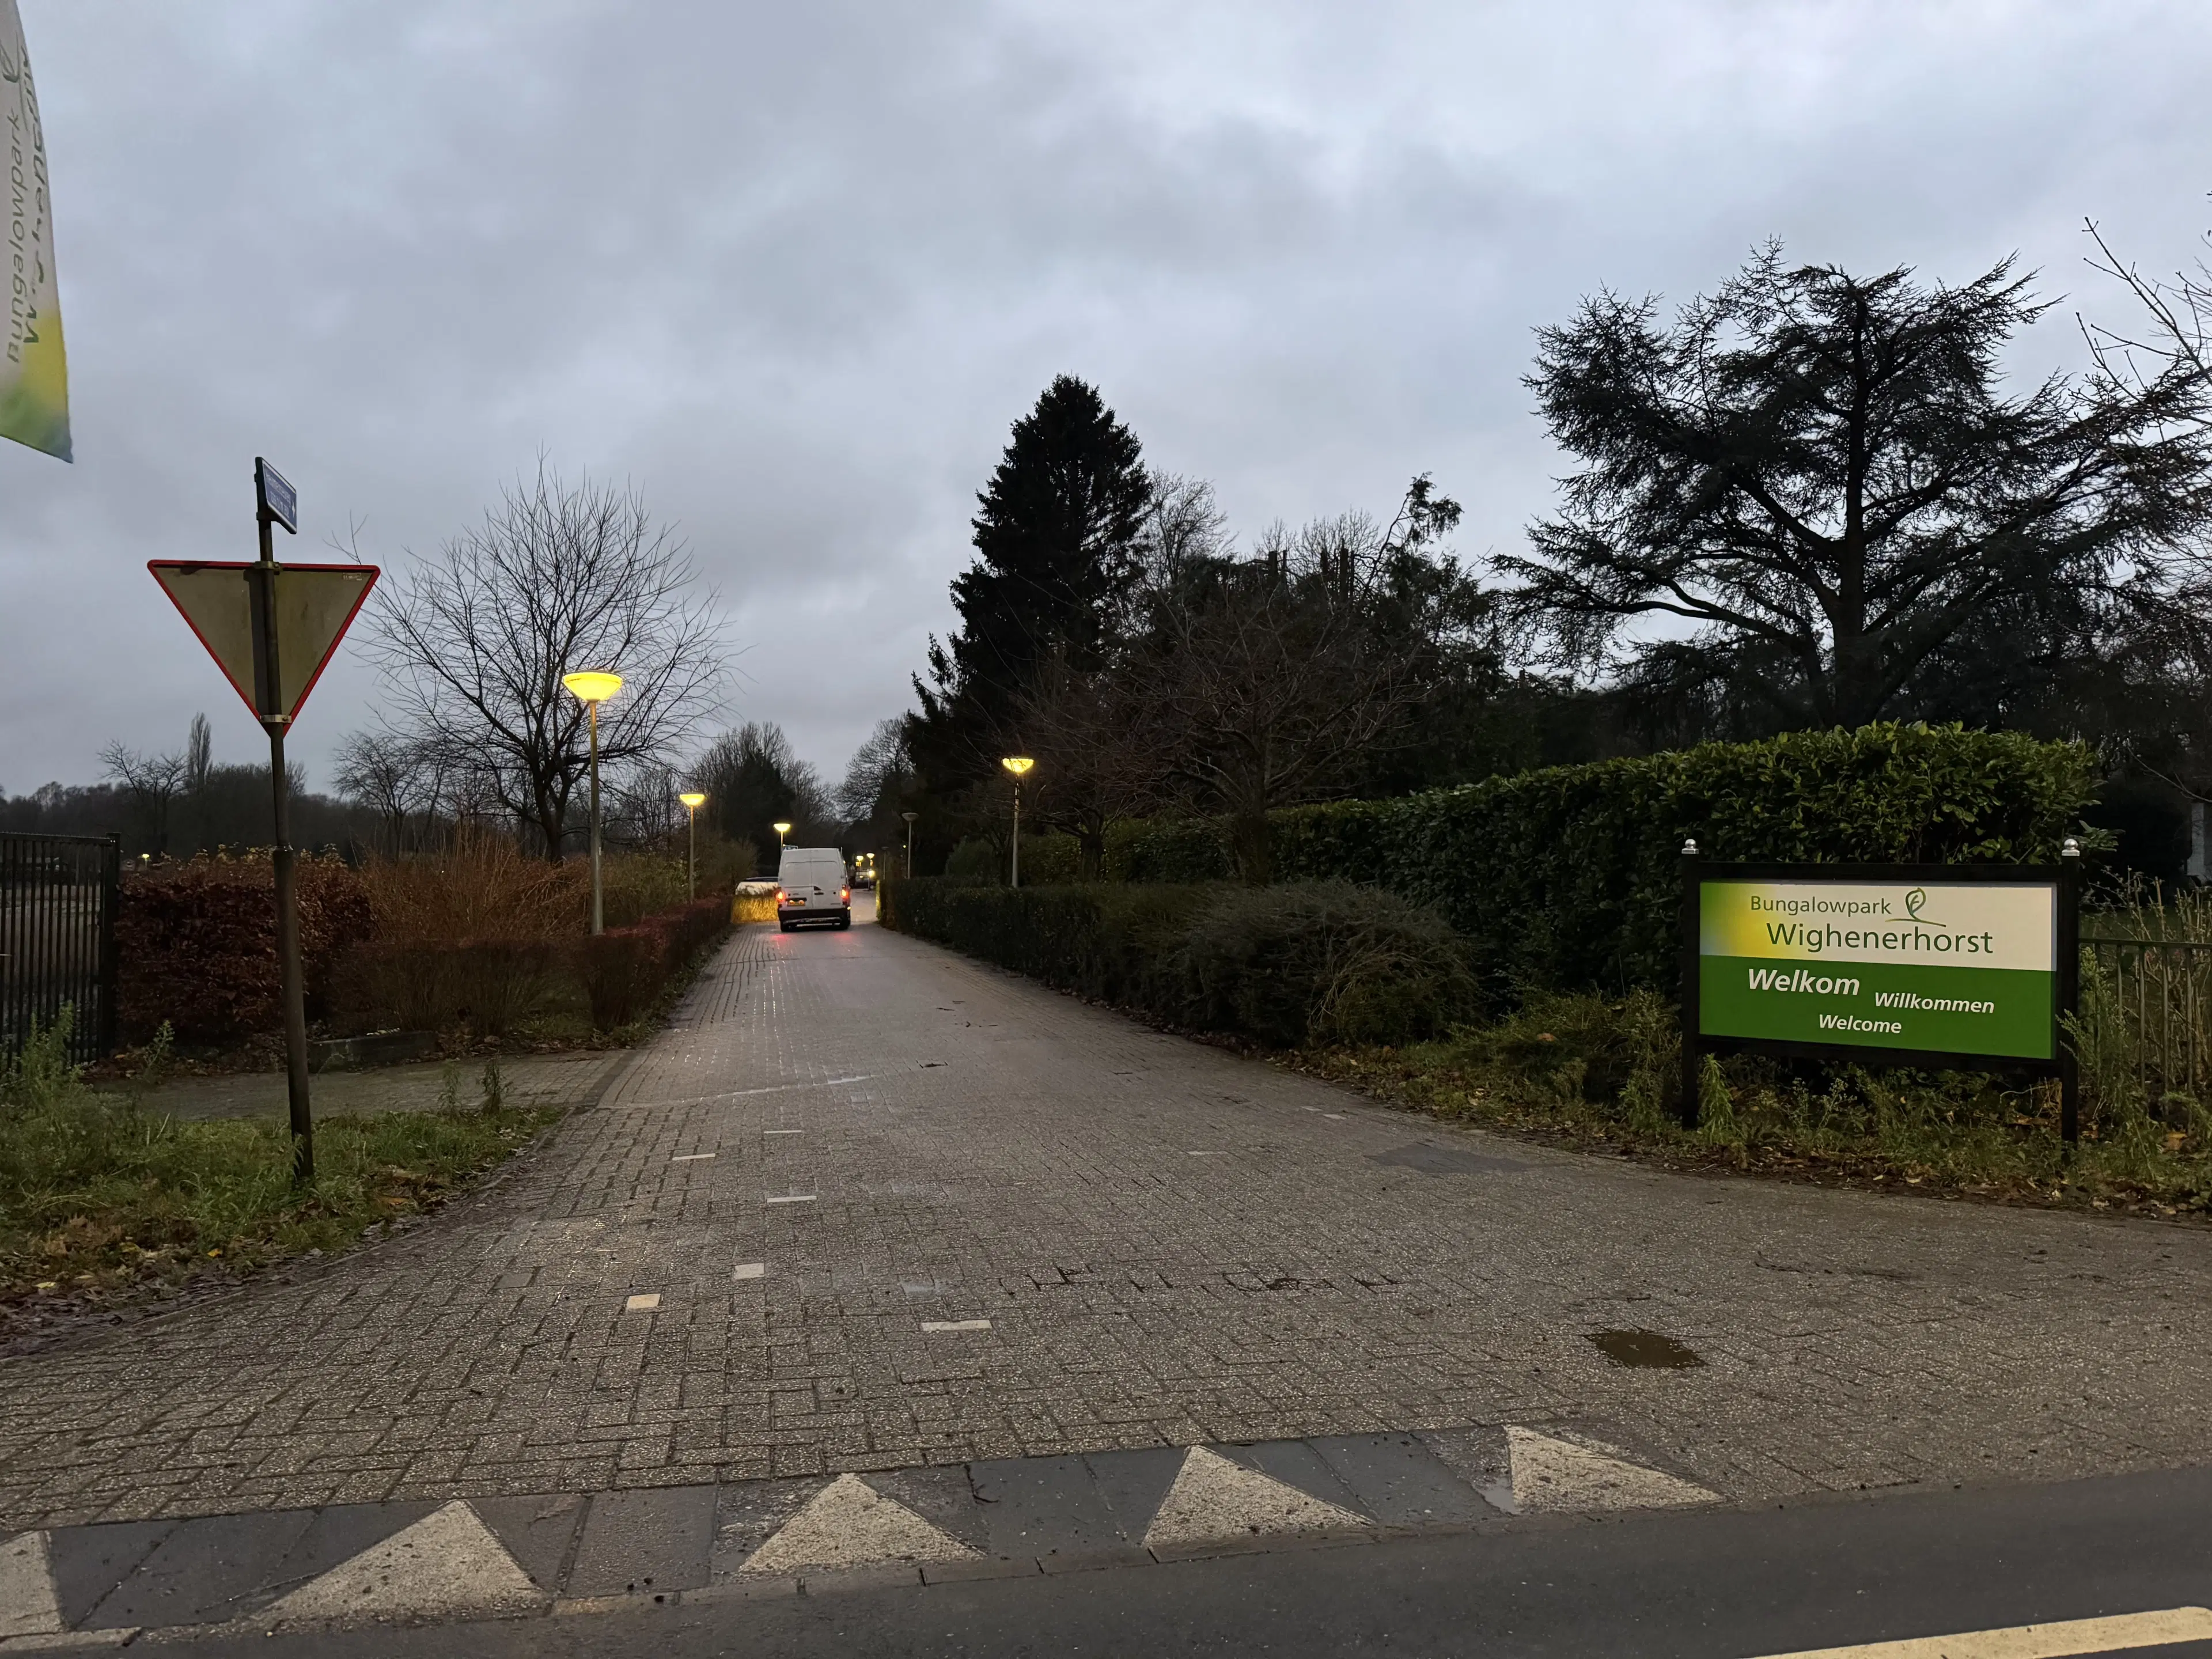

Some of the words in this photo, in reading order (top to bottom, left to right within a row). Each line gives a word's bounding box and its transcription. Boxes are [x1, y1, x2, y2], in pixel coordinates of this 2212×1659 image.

[1750, 895, 1892, 917] Bungalowpark
[1766, 923, 1994, 953] Wighenerhorst
[1748, 968, 1860, 995] Welkom
[1874, 992, 1995, 1014] Willkommen
[1819, 1014, 1902, 1033] Welcome
